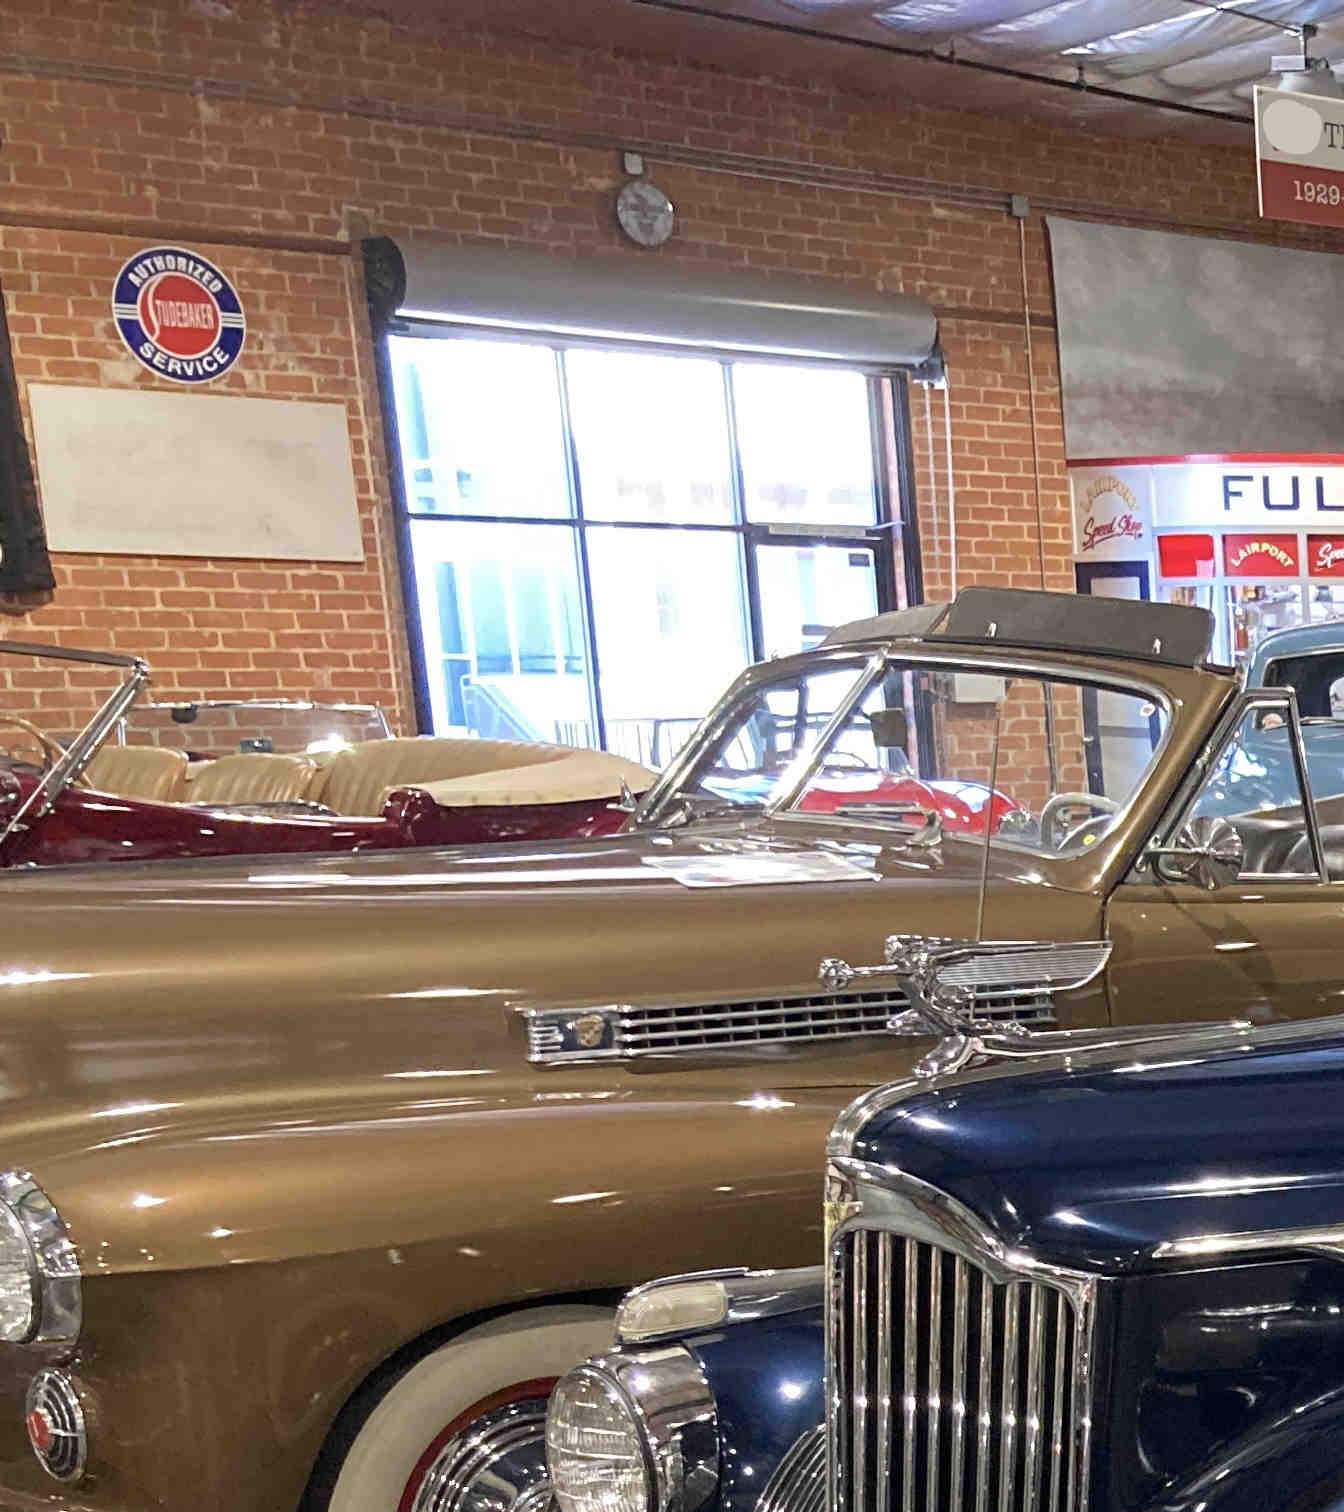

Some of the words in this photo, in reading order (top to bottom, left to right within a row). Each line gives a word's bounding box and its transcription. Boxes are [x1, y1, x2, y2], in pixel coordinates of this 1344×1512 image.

[128, 254, 223, 293] AUTHORIZED
[147, 275, 215, 341] STUDEBAKER
[140, 341, 230, 377] SERVICE
[1231, 541, 1295, 567] LAIRPORT
